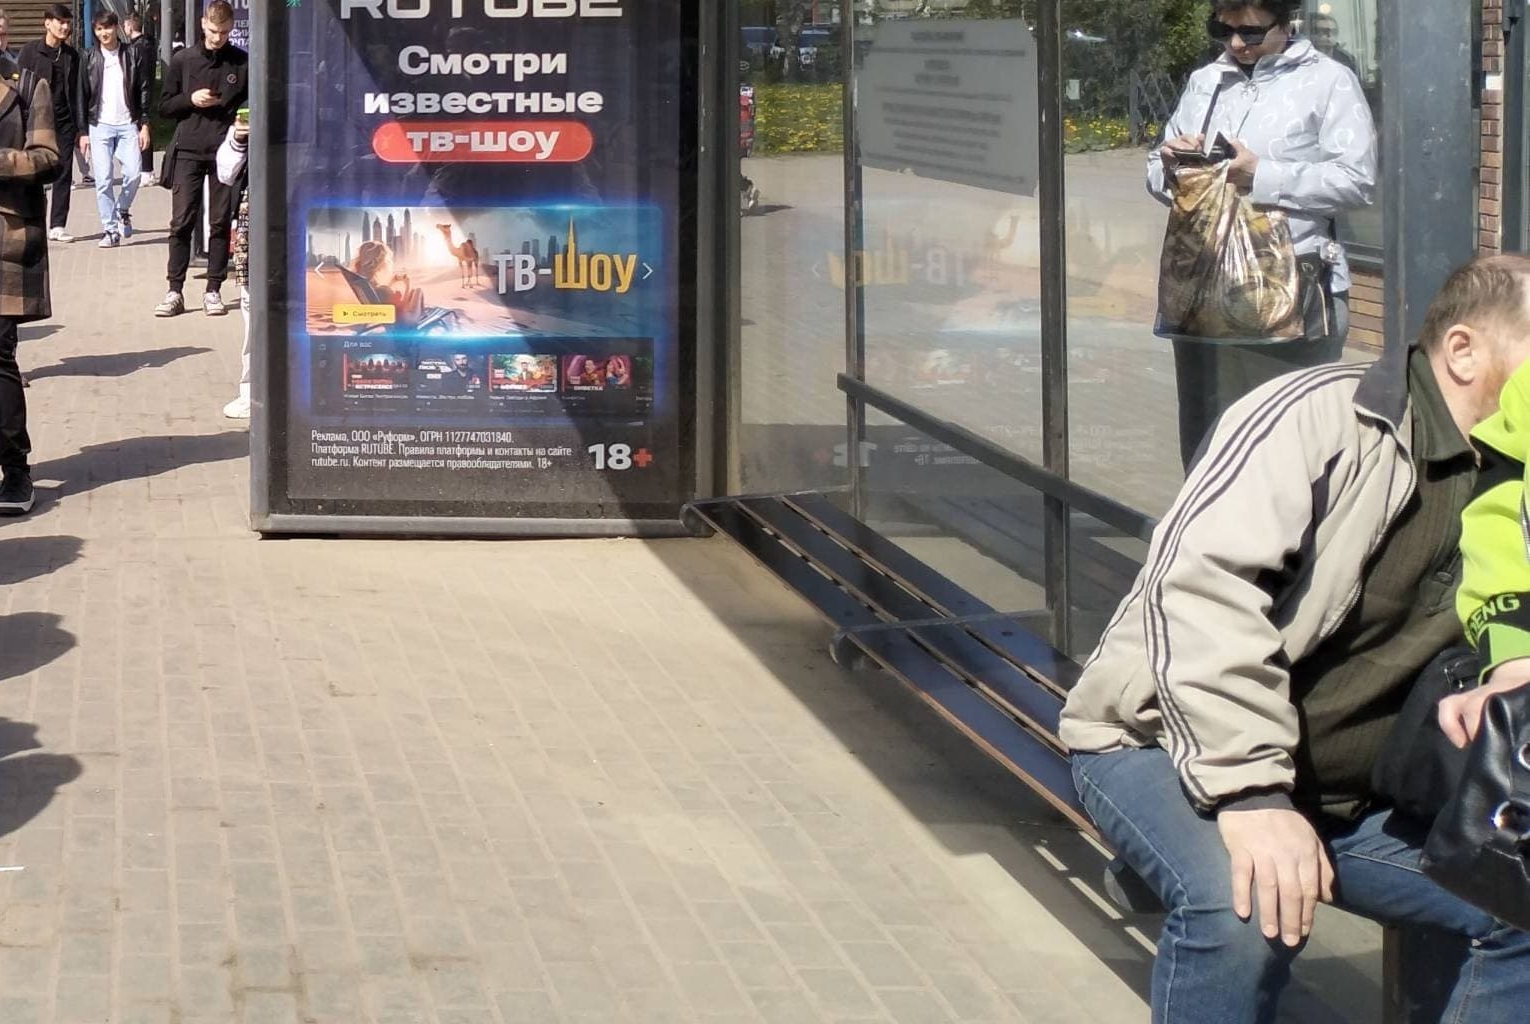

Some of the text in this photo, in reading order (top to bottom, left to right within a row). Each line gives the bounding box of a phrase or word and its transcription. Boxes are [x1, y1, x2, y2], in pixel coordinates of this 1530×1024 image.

[398, 45, 568, 82] Смотри
[364, 91, 604, 114] известные
[407, 130, 561, 160] тв-шоу
[493, 224, 638, 295] ТВ-ШОУ
[311, 429, 349, 443] Реклама,
[351, 430, 370, 442] ООО
[420, 430, 443, 443] ОГРН
[311, 442, 359, 456] Платформа
[361, 443, 396, 455] RUTUBE.
[399, 443, 435, 456] Правила
[436, 444, 485, 457] платформы
[495, 447, 534, 456] контакты
[535, 448, 546, 456] на
[547, 446, 572, 456] сайте
[587, 443, 654, 470] 18+
[352, 456, 387, 467] Контент
[388, 458, 445, 469] размещается
[537, 457, 553, 469] 18+
